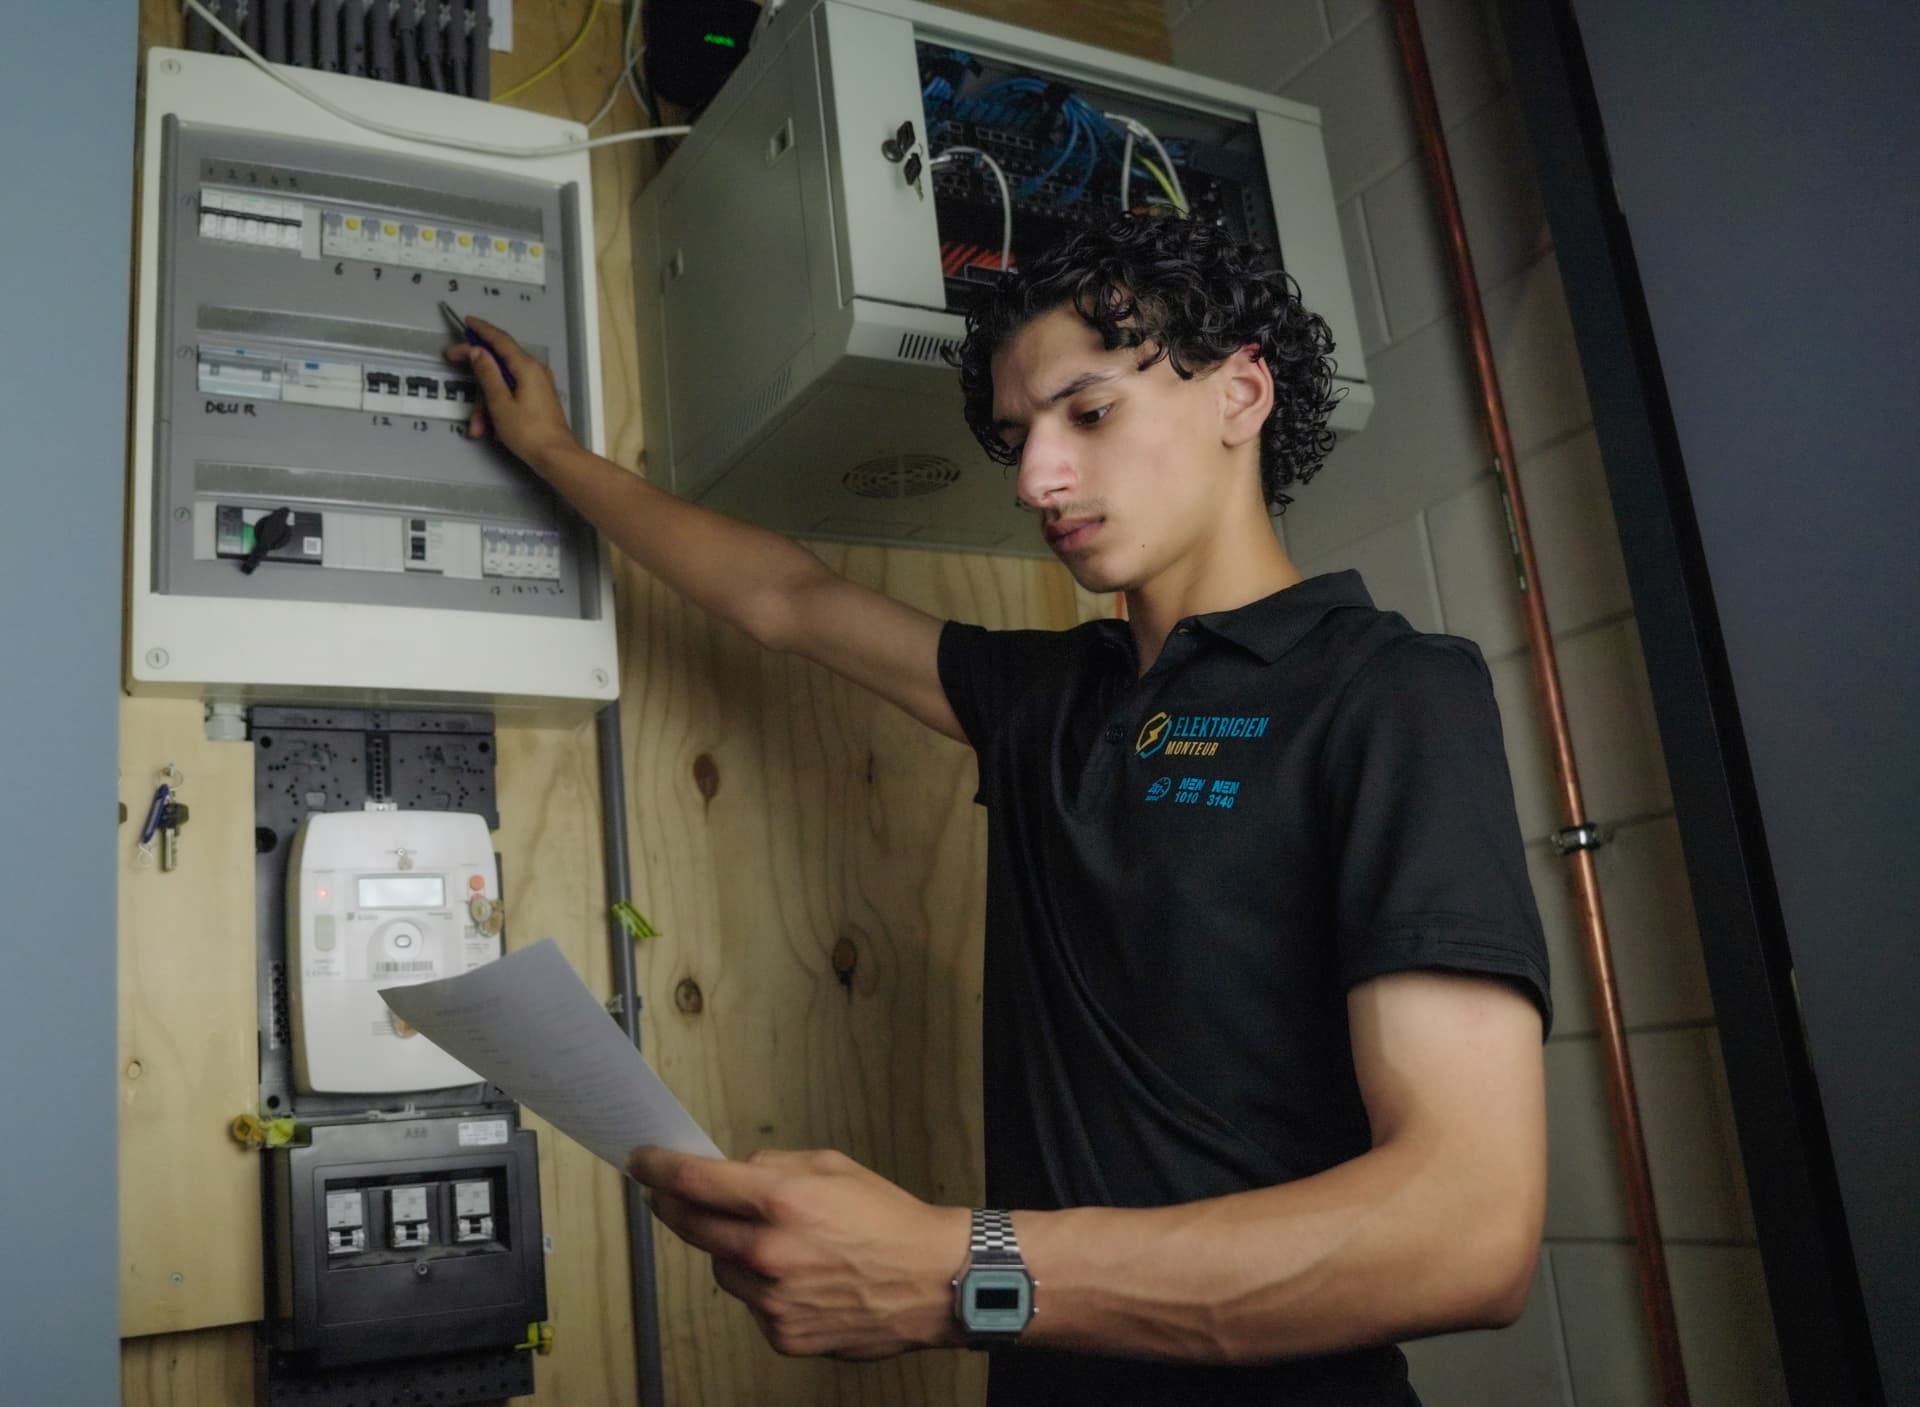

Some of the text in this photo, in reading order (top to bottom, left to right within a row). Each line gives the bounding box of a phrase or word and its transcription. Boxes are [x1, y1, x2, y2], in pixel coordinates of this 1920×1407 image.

[333, 262, 344, 276] 6
[373, 267, 382, 280] 7
[411, 272, 422, 285] 8
[449, 279, 459, 292] 9
[1173, 716, 1269, 738] ELEKTRICIEN
[1164, 741, 1219, 756] MONTEUR
[1178, 777, 1240, 795] NEN NEN
[1174, 791, 1200, 805] 1010
[1206, 794, 1234, 809] 3140
